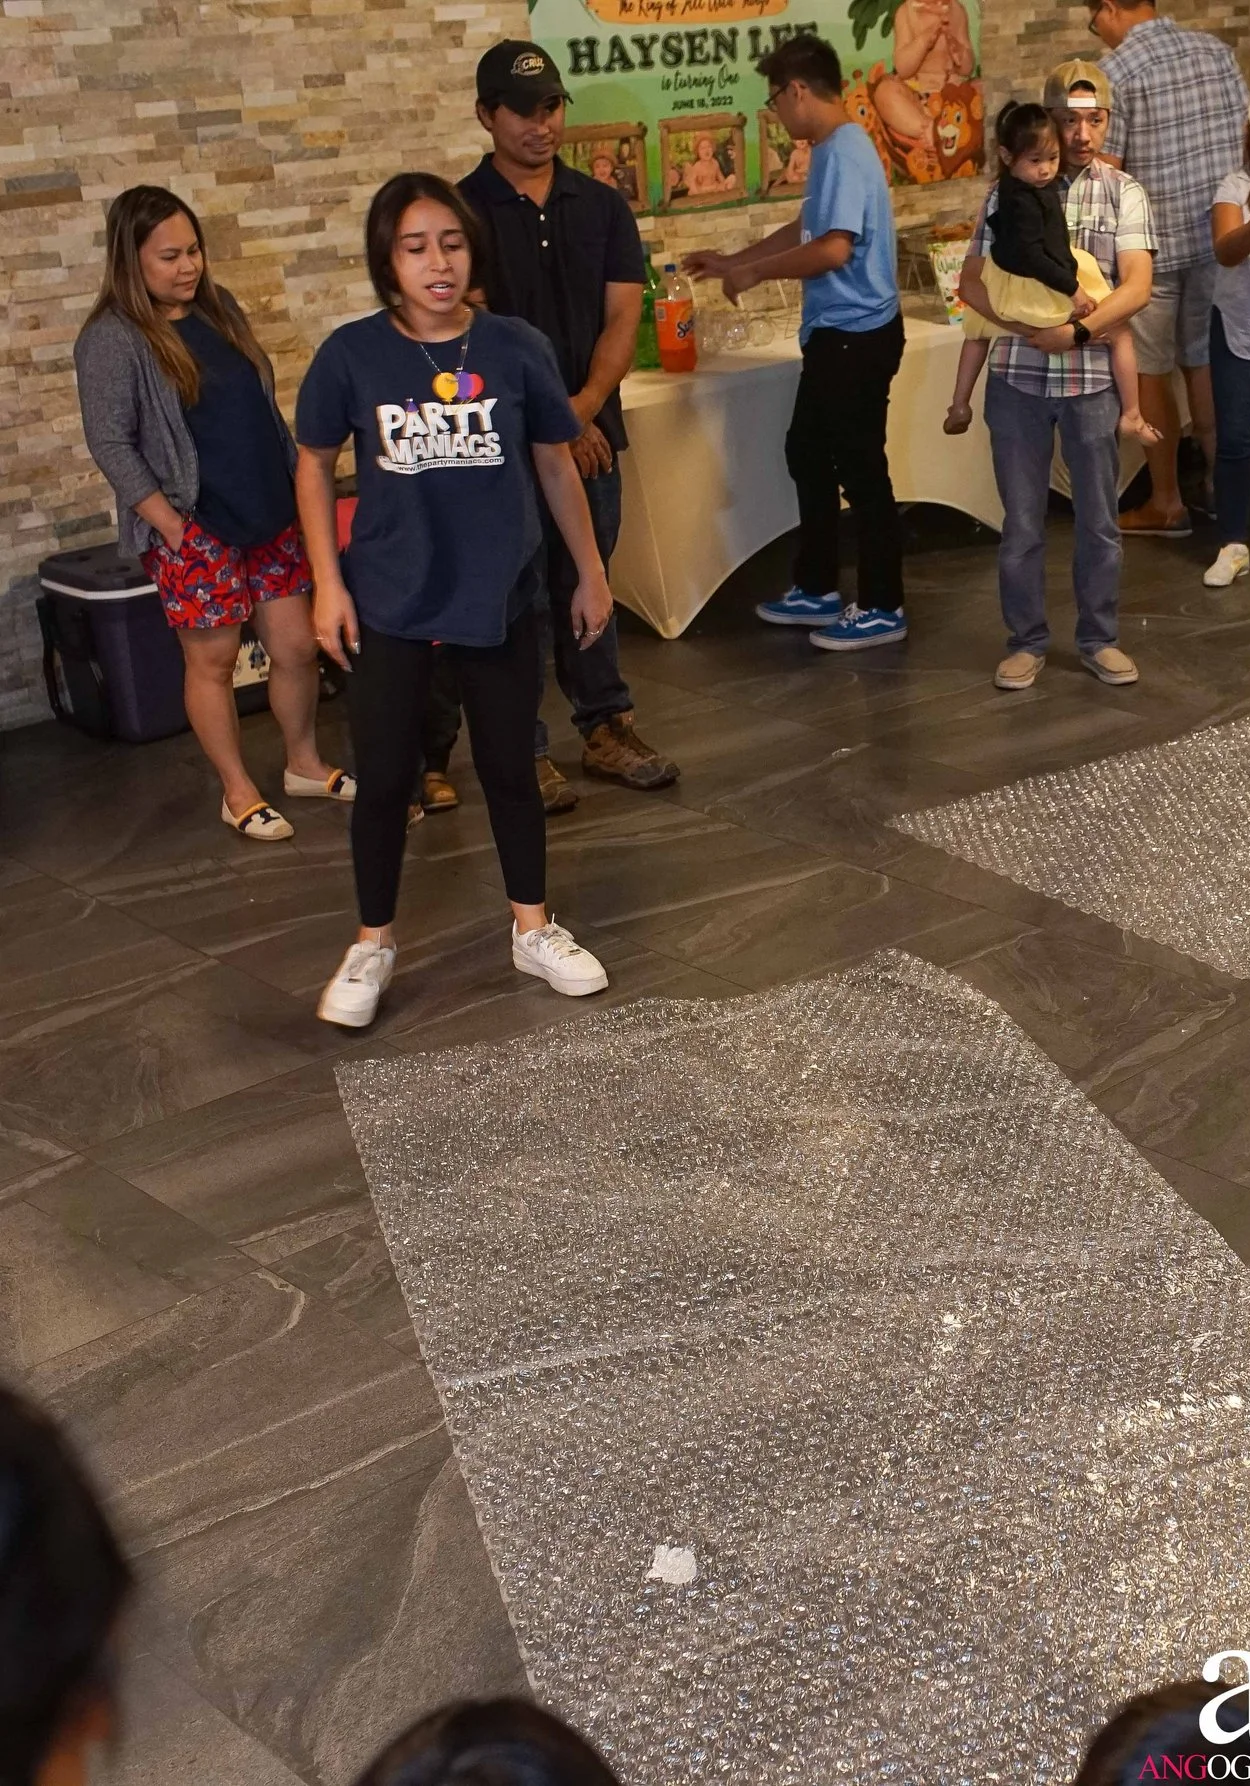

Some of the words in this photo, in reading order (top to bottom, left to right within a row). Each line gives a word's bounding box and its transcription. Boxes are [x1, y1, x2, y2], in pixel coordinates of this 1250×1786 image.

[566, 27, 740, 76] HAYSEN
[673, 69, 716, 97] turning
[717, 63, 740, 89] One
[671, 99, 695, 111] JUNE
[376, 398, 499, 439] PARTY
[397, 457, 502, 472] www.thepartymaniacs.com
